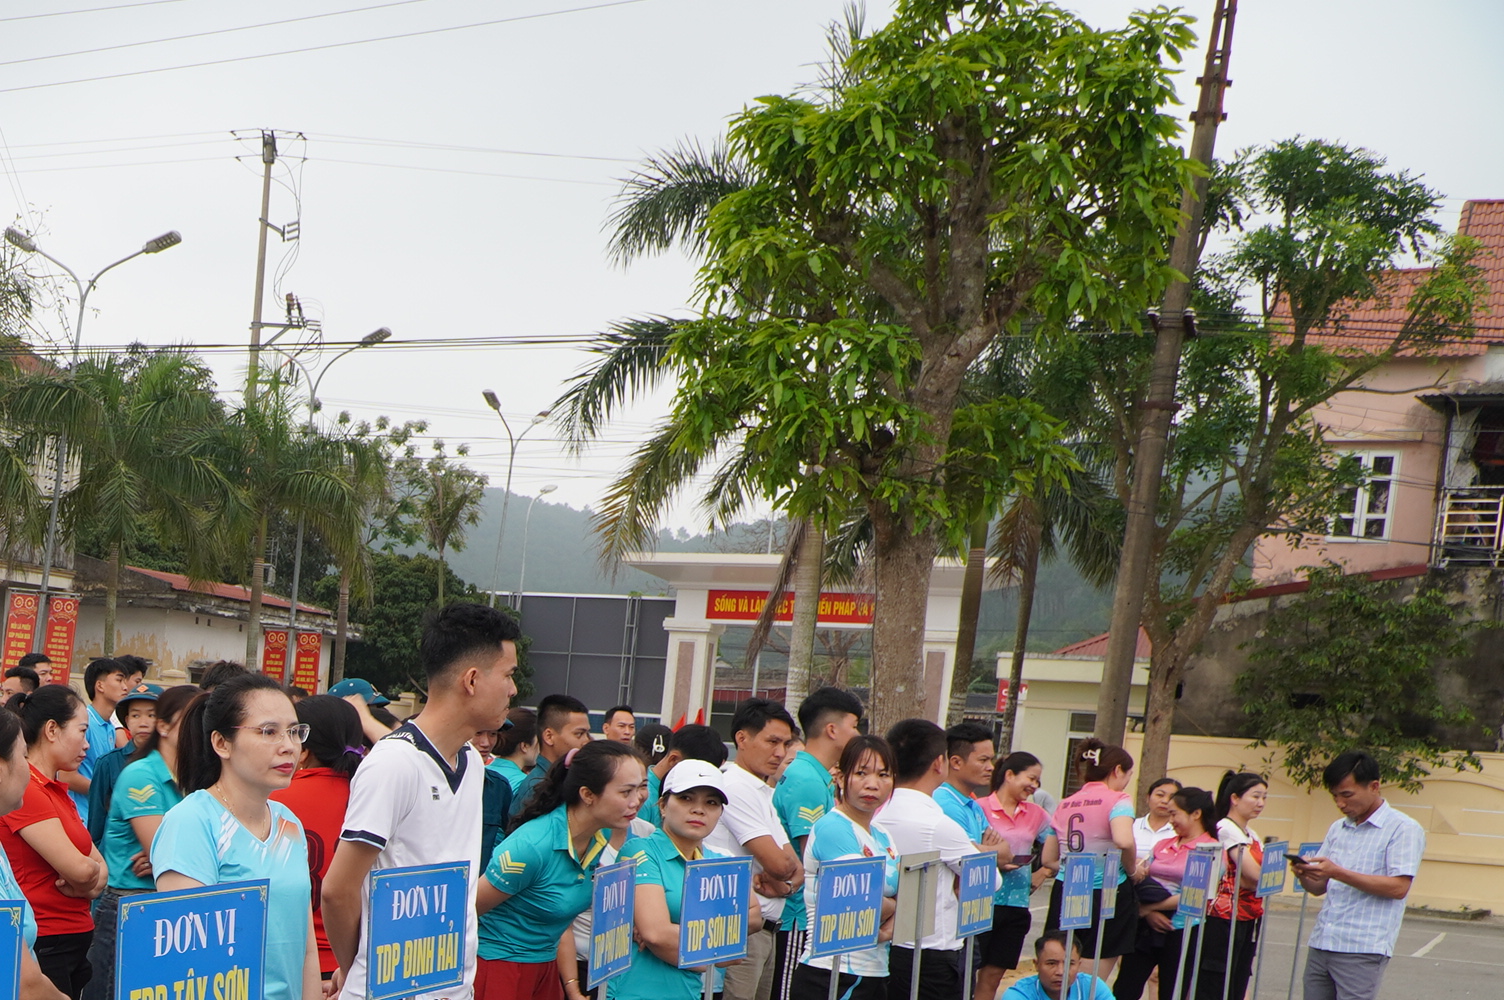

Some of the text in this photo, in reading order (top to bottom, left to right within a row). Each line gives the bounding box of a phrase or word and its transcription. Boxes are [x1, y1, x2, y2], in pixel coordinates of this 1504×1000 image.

[714, 594, 736, 612] SỐNG
[738, 597, 749, 613] VÀ
[817, 598, 831, 615] IẾN
[833, 599, 855, 616] PHÁP
[1067, 813, 1085, 852] 6
[699, 873, 738, 906] ĐƠN VỊ
[832, 872, 871, 902] ĐƠN VỊ
[968, 866, 983, 888] ĐƠN
[391, 883, 449, 923] ĐƠN VỊ
[602, 879, 627, 915] ĐƠN VỊ
[153, 908, 237, 958] ĐƠN VỊ
[687, 903, 742, 953] TDP SƠN HẢI
[819, 905, 877, 944] TDP VĂN SƠN
[376, 942, 401, 986] TDP
[437, 919, 459, 972] HẢI
